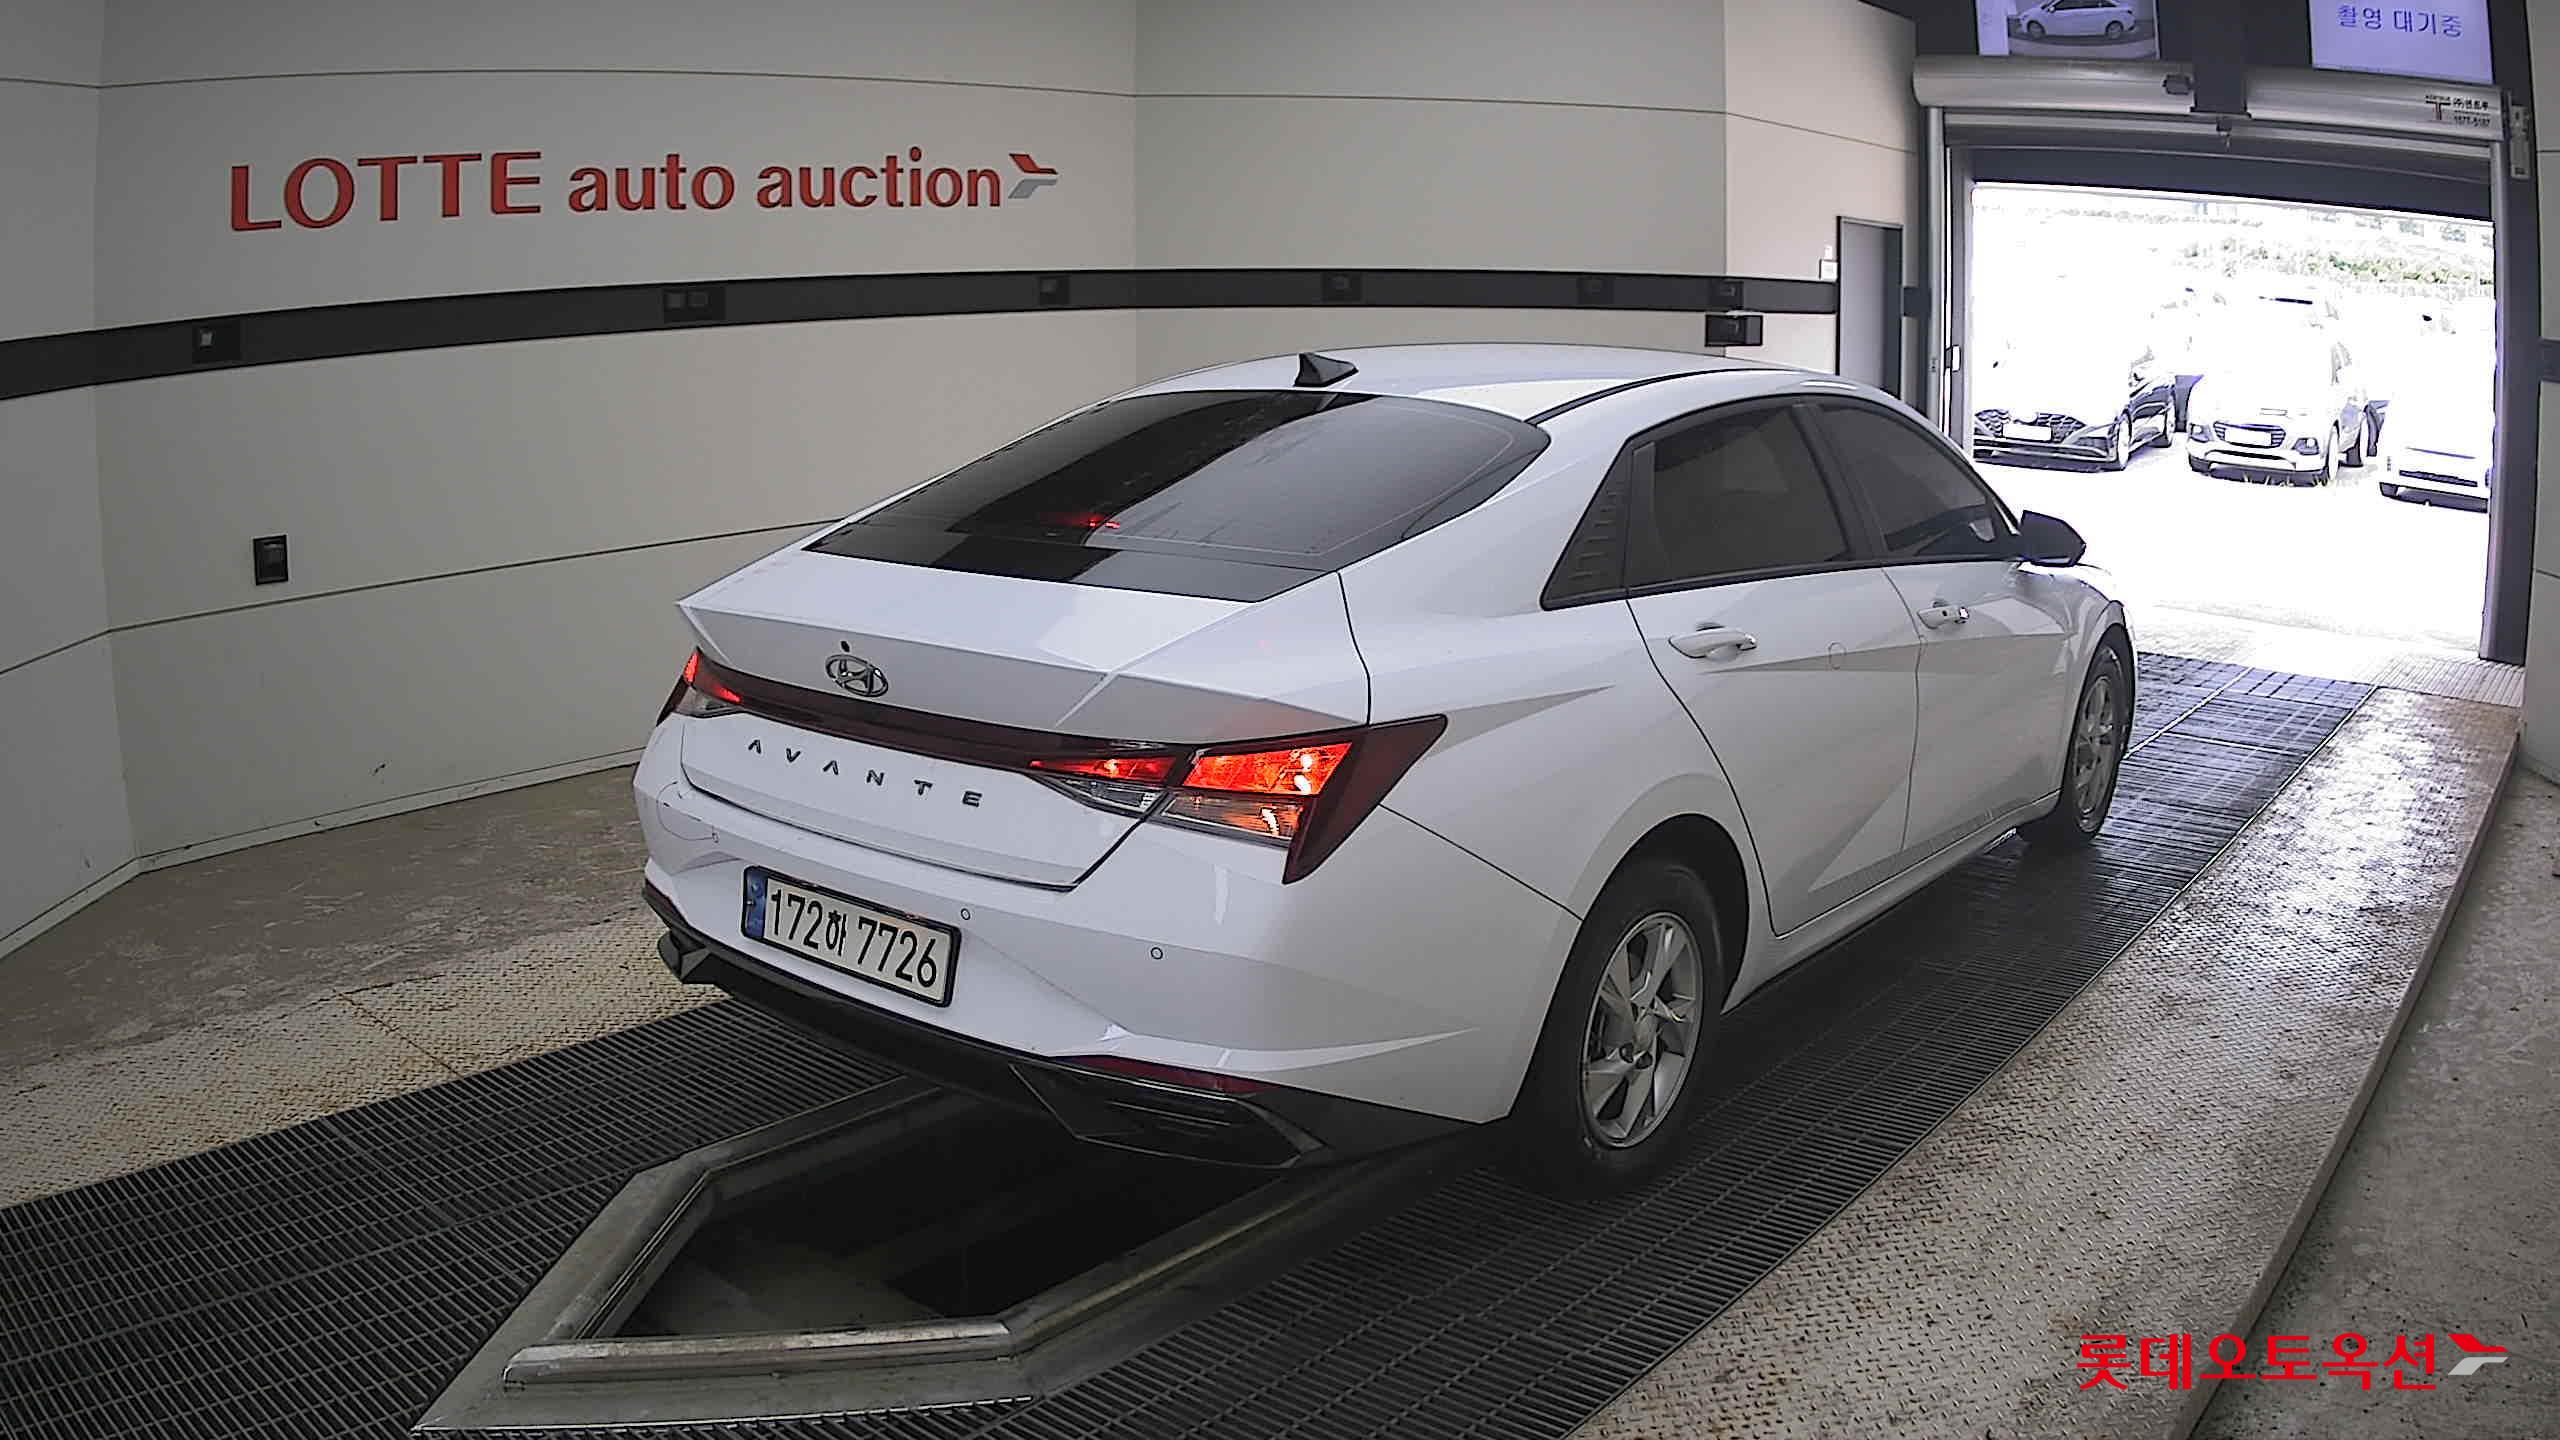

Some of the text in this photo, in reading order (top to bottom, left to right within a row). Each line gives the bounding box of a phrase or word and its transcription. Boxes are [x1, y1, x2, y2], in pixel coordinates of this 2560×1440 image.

[2338, 5, 2462, 37] 촬영 대기중
[231, 146, 1001, 231] LOTTE auto auction
[748, 739, 983, 807] AVANTE
[771, 888, 937, 988] 172하 7726
